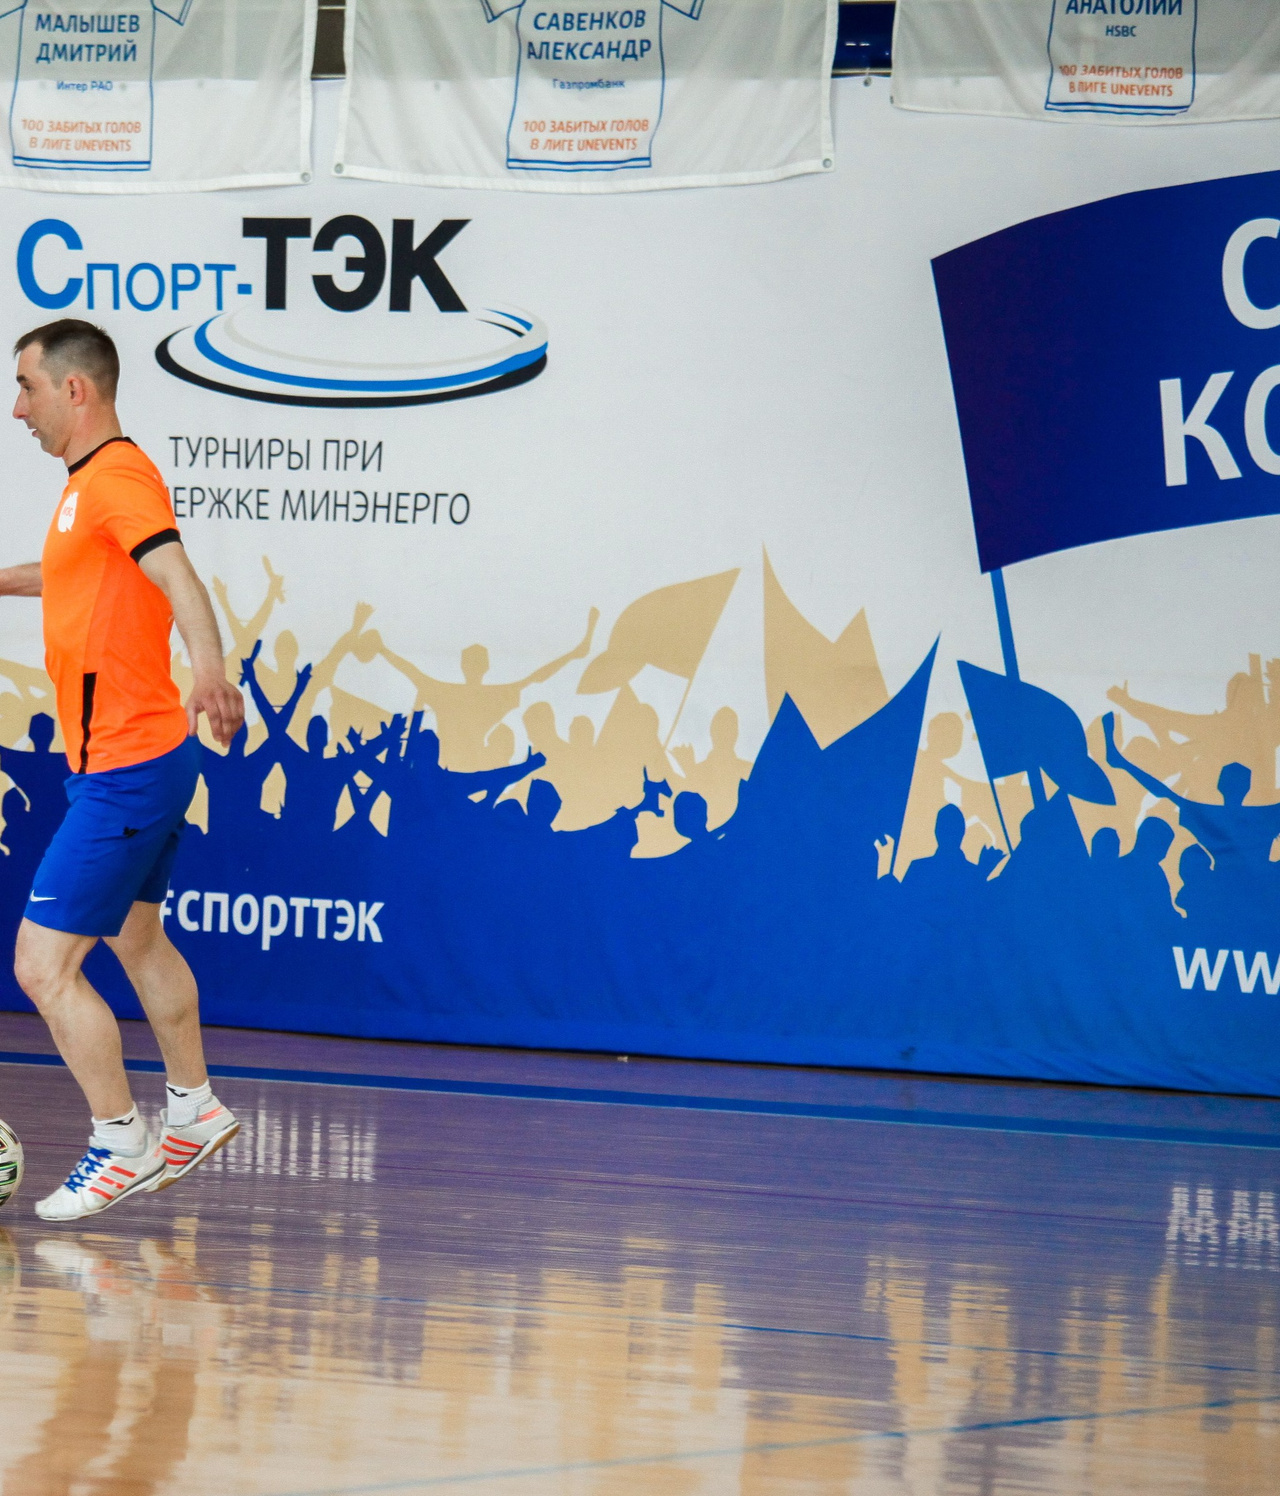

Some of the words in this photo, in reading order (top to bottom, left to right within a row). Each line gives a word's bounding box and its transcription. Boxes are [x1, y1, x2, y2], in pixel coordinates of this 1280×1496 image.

[35, 13, 140, 33] МАЛЫШЕВ
[533, 9, 646, 31] САВЕНКОВ
[1105, 25, 1137, 37] HSBC
[35, 39, 137, 64] ДМИТРИЙ
[527, 39, 652, 62] АЛЕКСАНДР
[1059, 65, 1077, 76] 100
[1081, 65, 1142, 79] ЗАБИТЫХ
[1145, 66, 1183, 80] ГОЛОВ
[56, 80, 87, 93] Интер
[91, 81, 113, 91] РАО
[552, 78, 626, 91] Газпромбанк
[1068, 82, 1076, 94] В
[1078, 82, 1107, 94] ЛИГЕ
[1110, 84, 1173, 97] UNEVENTS
[22, 119, 43, 131] 100
[47, 120, 102, 134] ЗАБИТЫХ
[105, 121, 142, 134] ГОЛОВ
[523, 120, 545, 132] 100
[549, 120, 607, 133] ЗАБИТЫХ
[610, 119, 649, 132] ГОЛОВ
[29, 137, 38, 149] В
[41, 138, 71, 151] ЛИГЕ
[74, 139, 131, 152] UNEVENTS
[530, 139, 539, 150] В
[543, 139, 574, 152] ЛИГЕ
[577, 138, 637, 152] UNEVENTS
[169, 436, 311, 472] ТУРНИРЫ
[323, 439, 383, 472] ПРИ
[167, 486, 269, 521] ЕРЖКЕ
[281, 488, 470, 525] МИНЭНЕРГО
